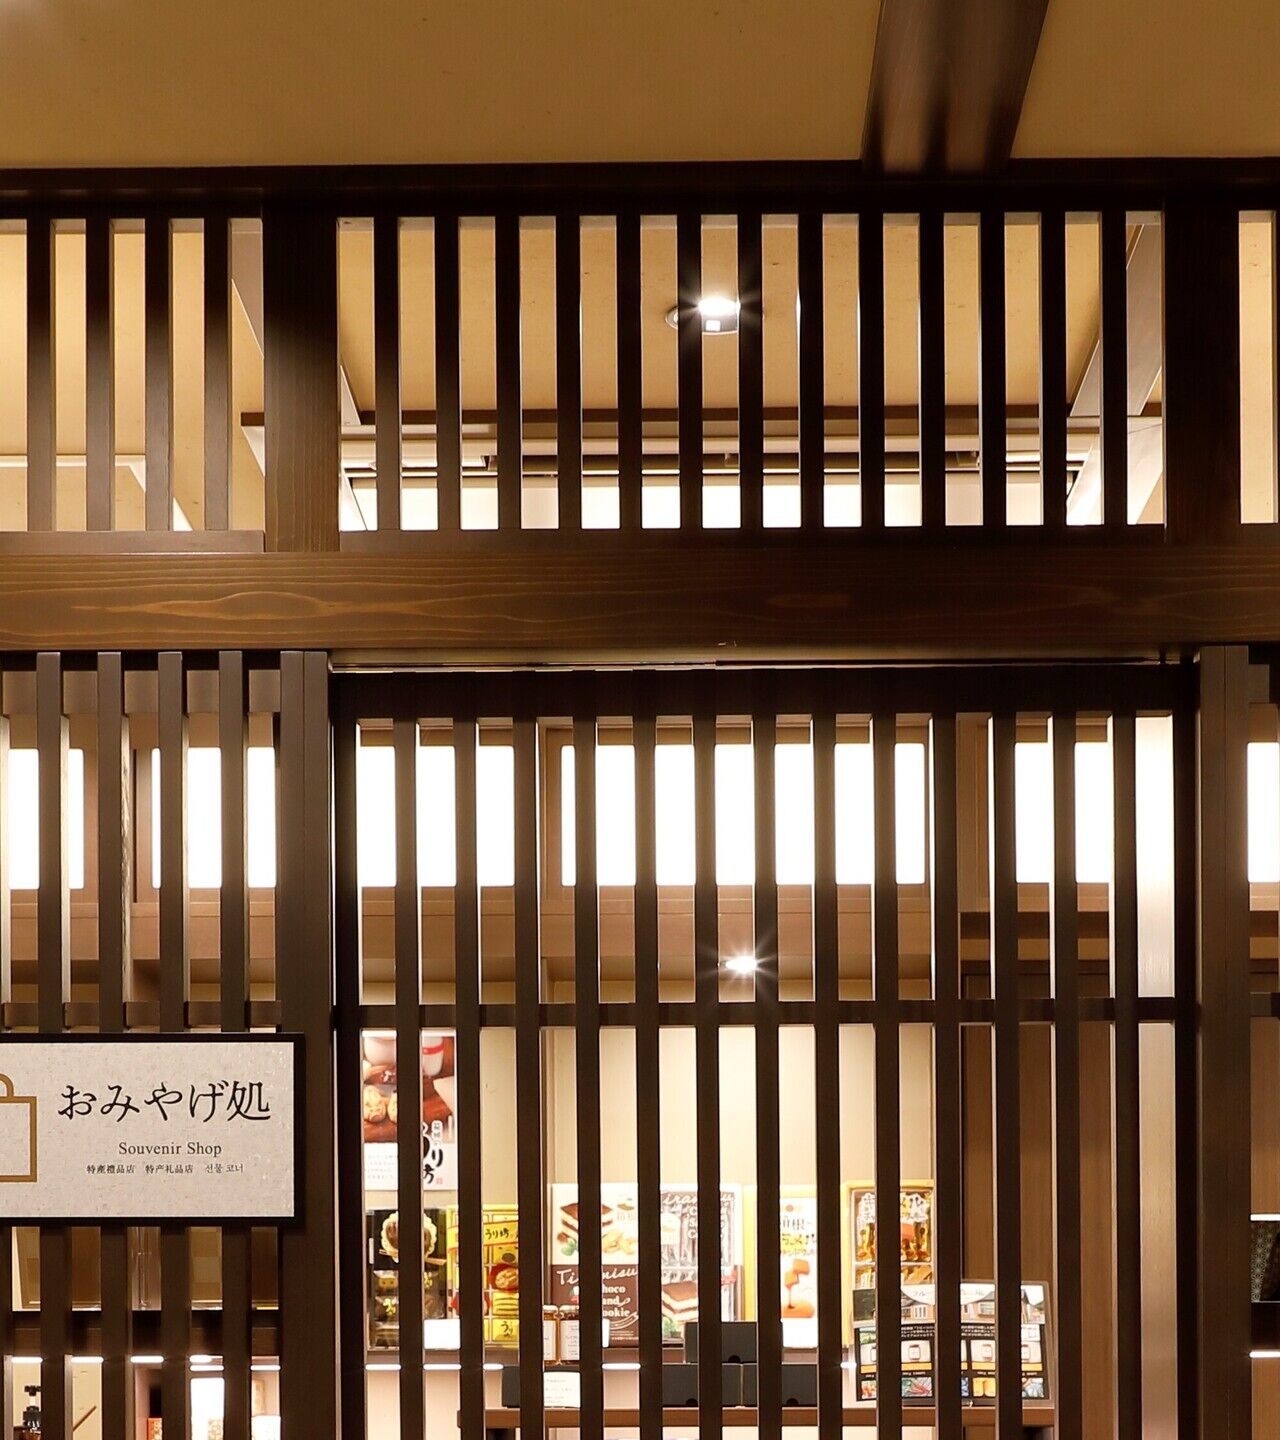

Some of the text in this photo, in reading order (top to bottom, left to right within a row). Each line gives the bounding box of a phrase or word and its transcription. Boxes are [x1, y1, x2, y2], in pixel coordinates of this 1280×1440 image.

[57, 1079, 271, 1123] おみやげ処
[118, 1141, 222, 1158] Souvenir Shop
[86, 1163, 135, 1175] 特產禮品店
[145, 1163, 194, 1175] 特产礼品店
[205, 1163, 244, 1174] 선물 코너
[602, 1284, 626, 1294] hoco
[602, 1308, 631, 1318] ookie
